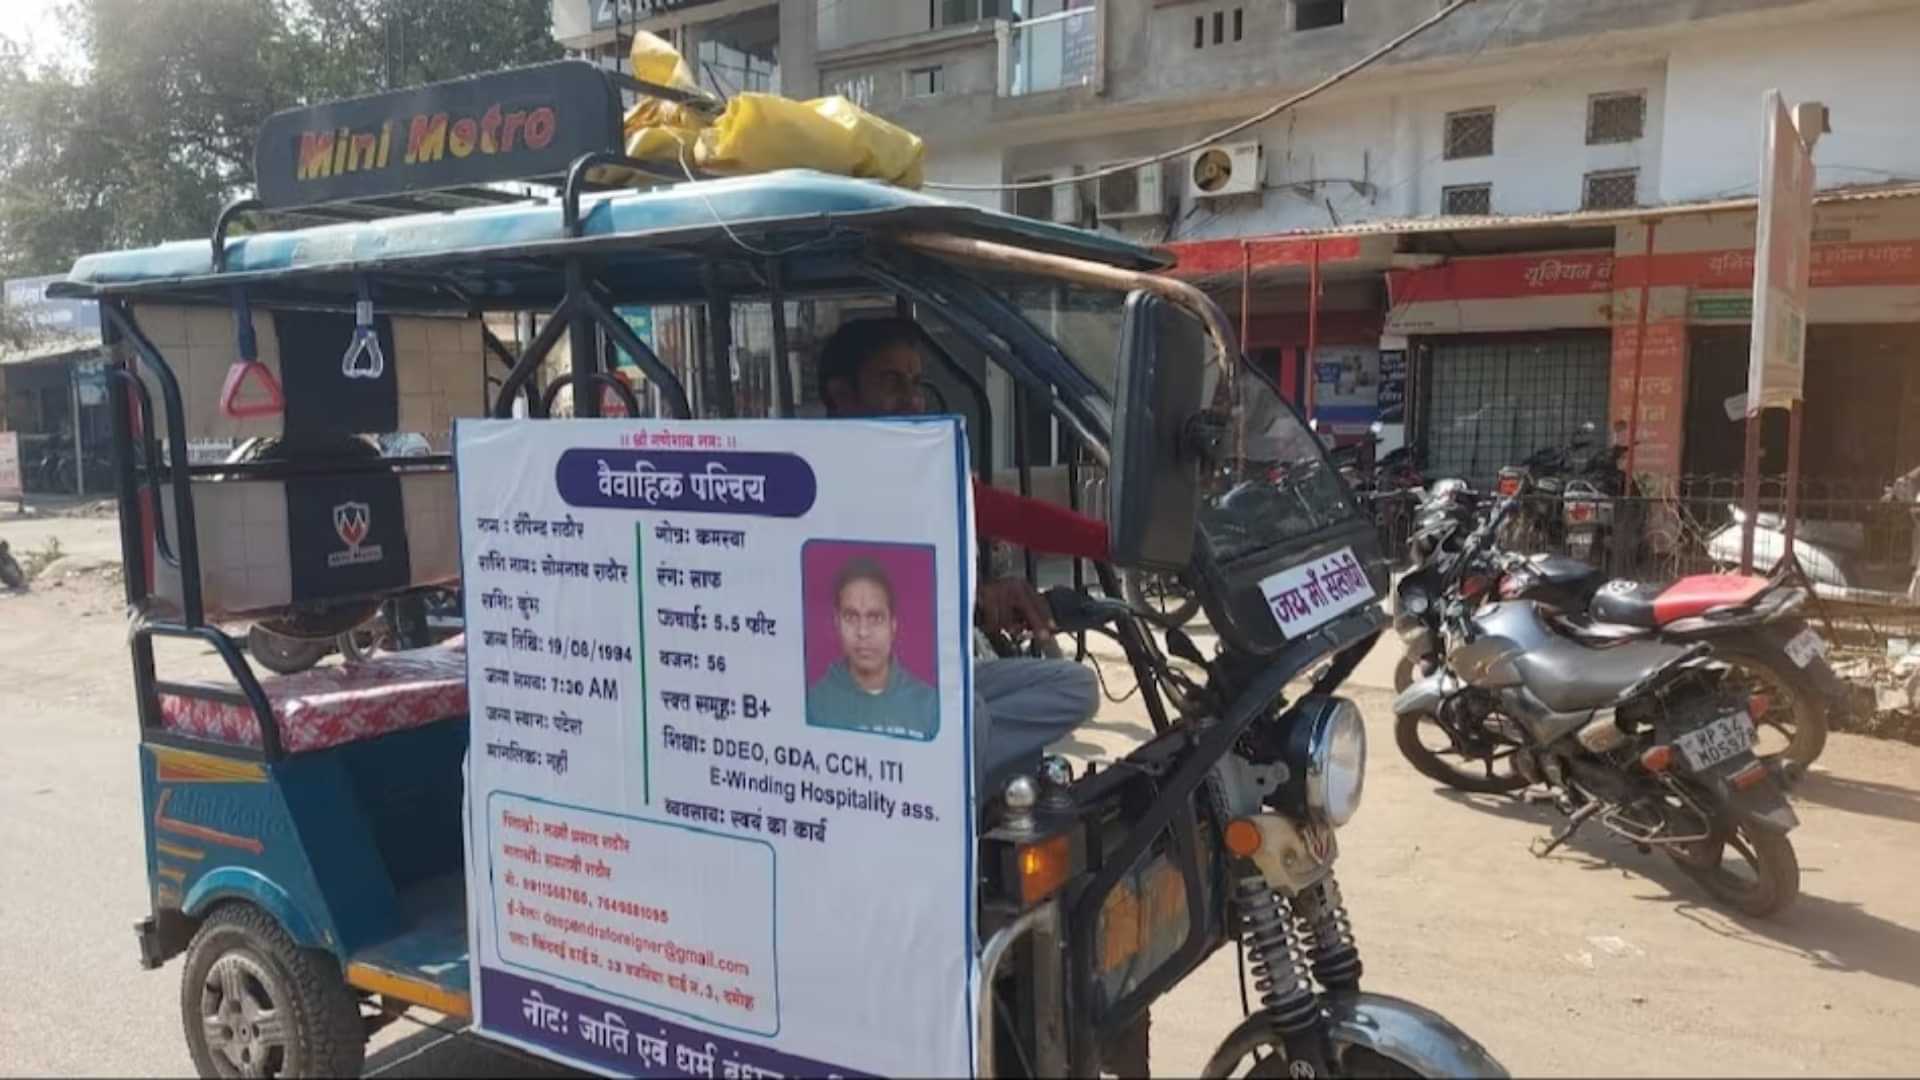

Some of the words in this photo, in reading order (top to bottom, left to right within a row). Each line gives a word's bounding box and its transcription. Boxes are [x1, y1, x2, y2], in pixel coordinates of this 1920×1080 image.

[297, 118, 392, 181] Mini
[405, 103, 555, 165] Metro
[597, 459, 684, 505] वैवाहिक
[690, 462, 767, 503] परिचय
[714, 612, 741, 634] 5.5
[706, 654, 727, 673] 56
[588, 677, 620, 702] AM
[742, 694, 771, 719] B+
[774, 746, 821, 775] GDA,
[825, 753, 873, 782] CCH,
[879, 760, 904, 785] ITI
[709, 766, 797, 804] E-Winding
[800, 781, 896, 820] Hospitality
[901, 798, 940, 823] ass.
[767, 816, 787, 838] का
[521, 988, 569, 1035] नोट:
[578, 1011, 630, 1056] जाति
[636, 1028, 669, 1069] एवं
[676, 1040, 717, 1079] धर्म
